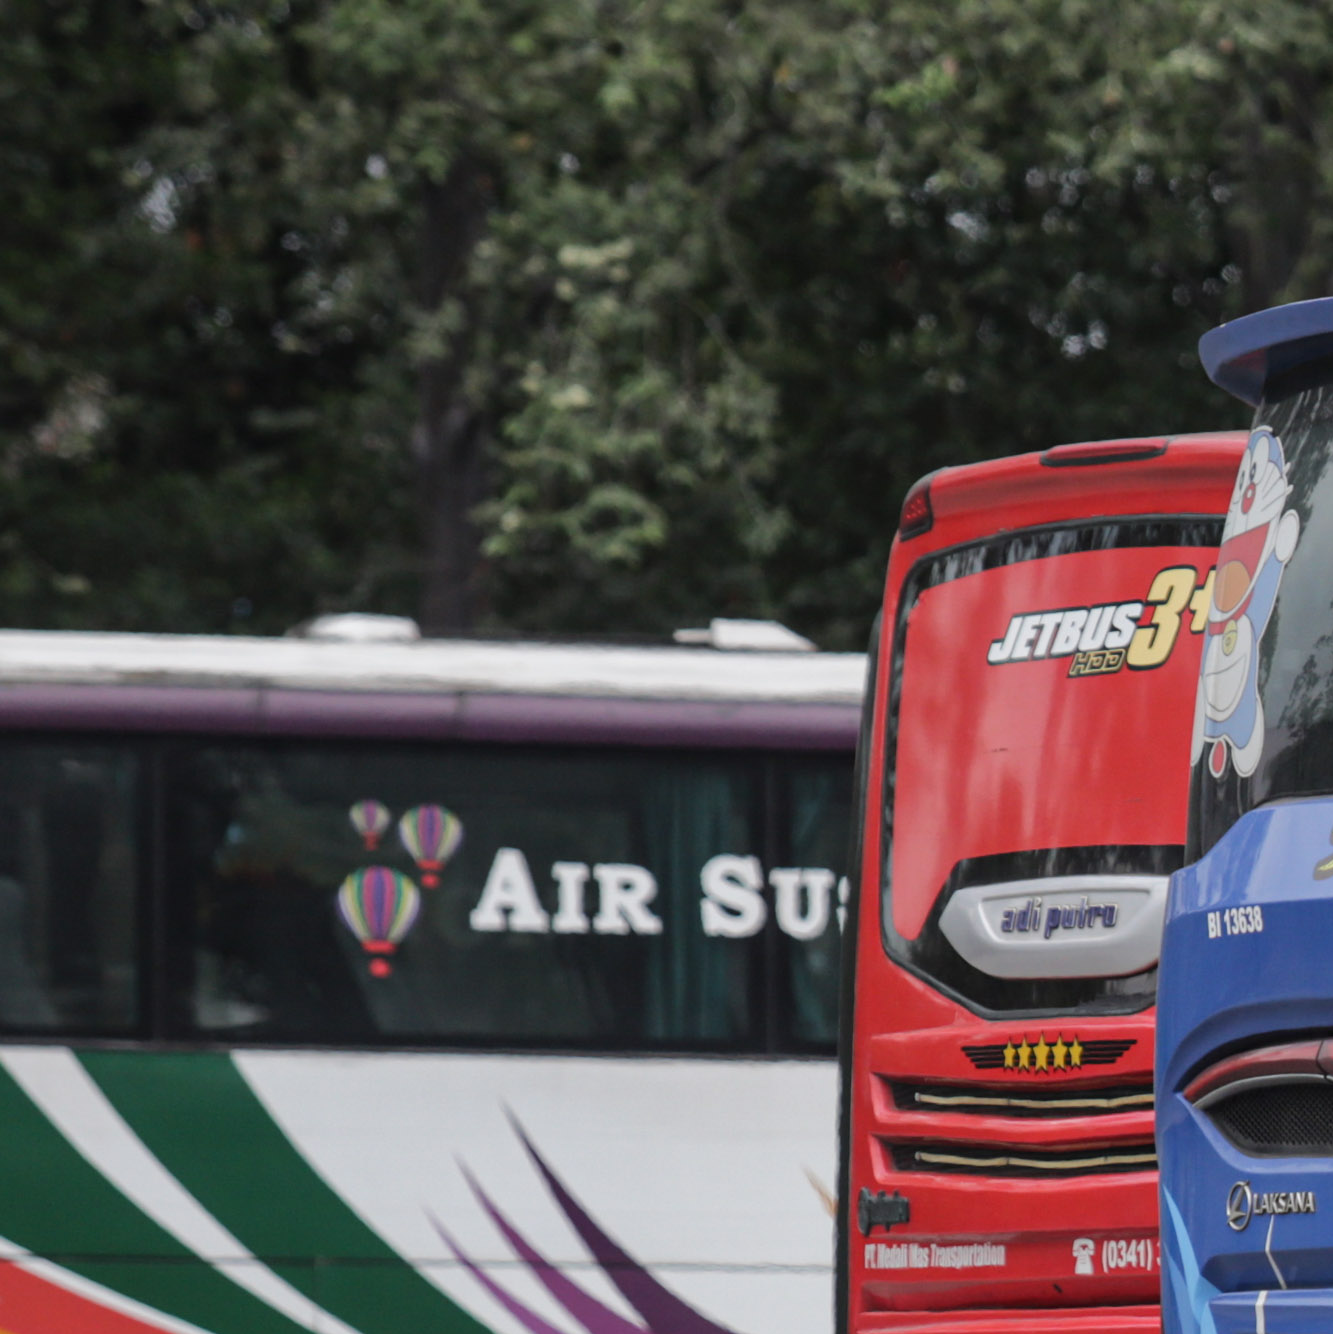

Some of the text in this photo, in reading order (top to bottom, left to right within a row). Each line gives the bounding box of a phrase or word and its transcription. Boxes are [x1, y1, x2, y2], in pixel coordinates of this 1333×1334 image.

[987, 600, 1144, 665] JETBUS
[1068, 648, 1126, 678] HDD
[470, 848, 850, 940] AIR SU
[1001, 897, 1042, 933] adi
[1207, 906, 1263, 939] BI 13638
[1253, 1191, 1316, 1216] LAKSANA
[1102, 1239, 1153, 1273] (0341)
